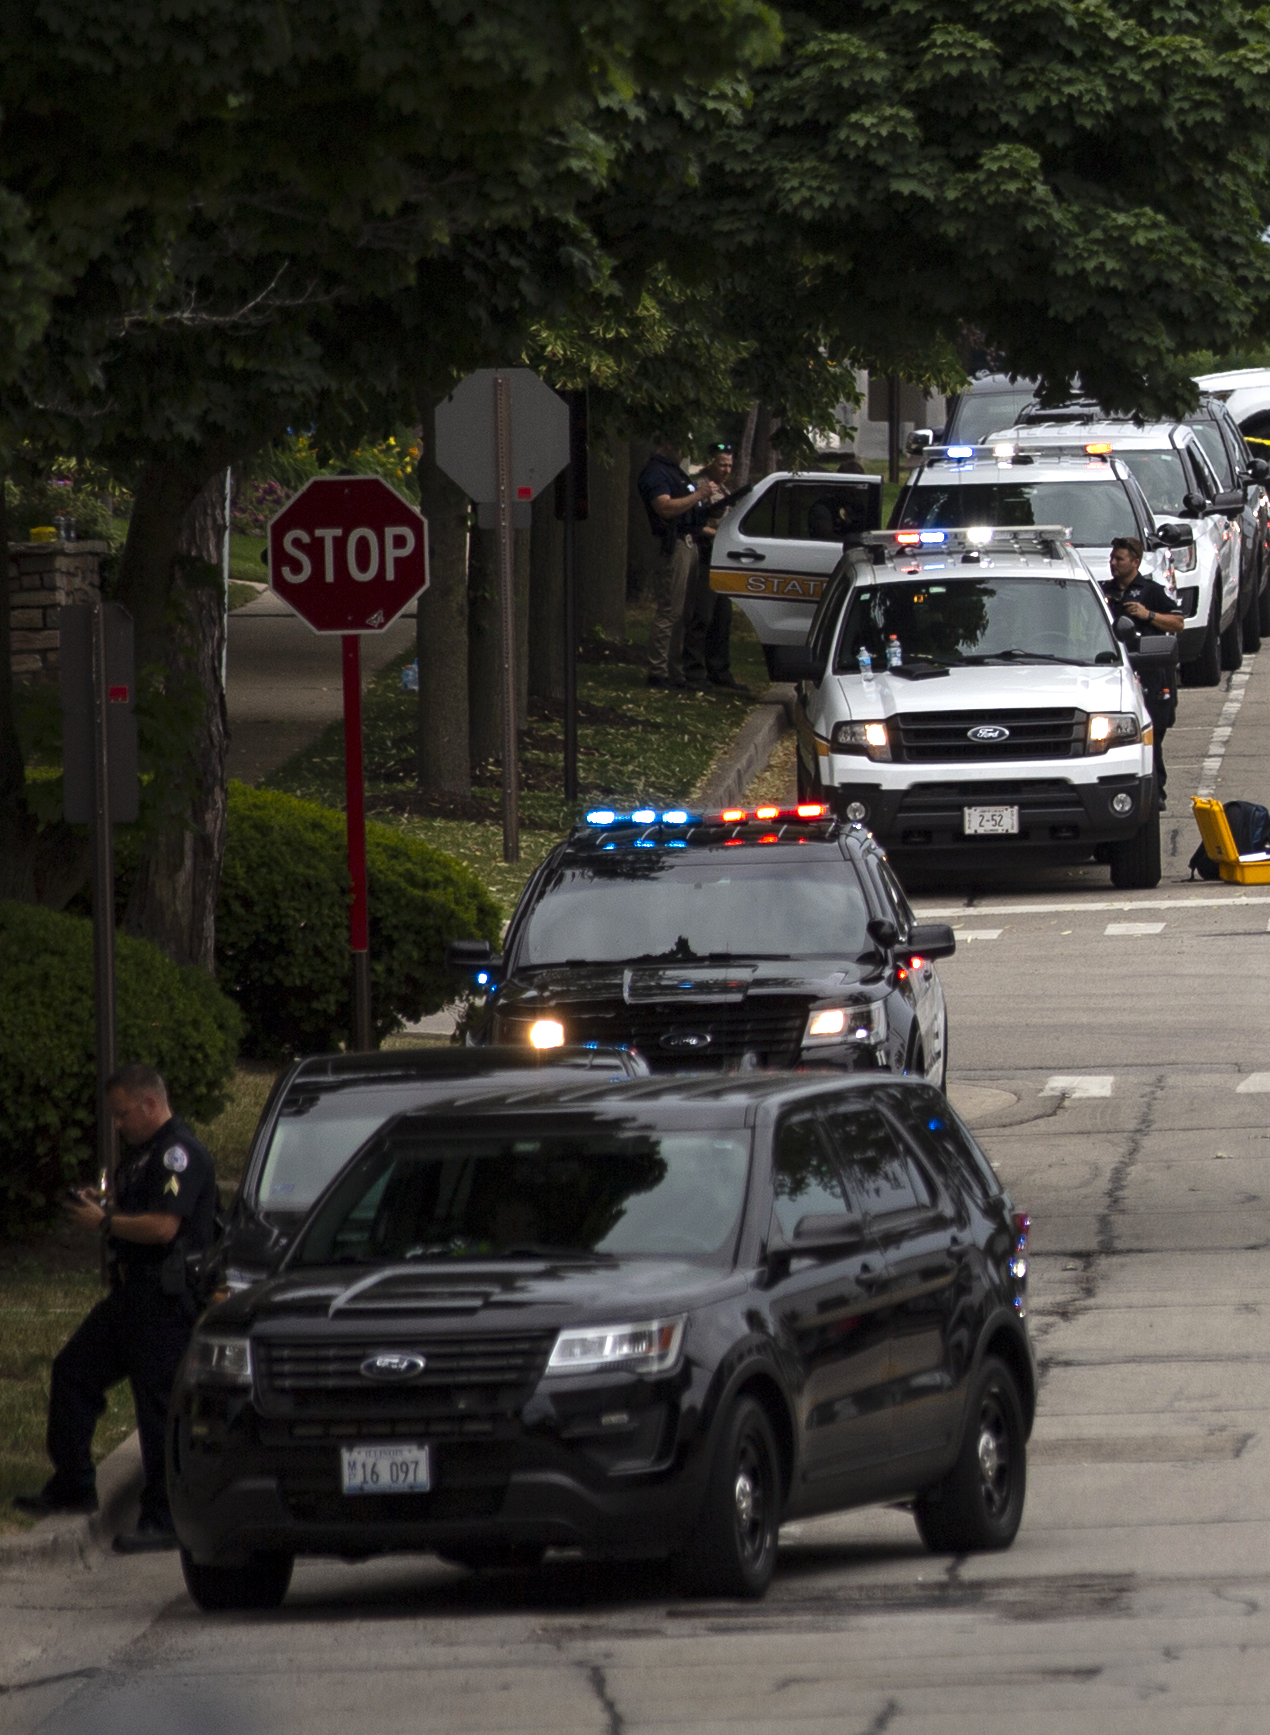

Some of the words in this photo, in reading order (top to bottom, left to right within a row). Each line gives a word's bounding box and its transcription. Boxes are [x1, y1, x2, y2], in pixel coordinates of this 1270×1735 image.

[281, 526, 416, 584] STOP
[746, 576, 828, 595] STAT
[977, 728, 999, 738] Ford
[979, 814, 1003, 827] 2-52
[361, 1462, 379, 1484] 16
[390, 1461, 419, 1483] 097
